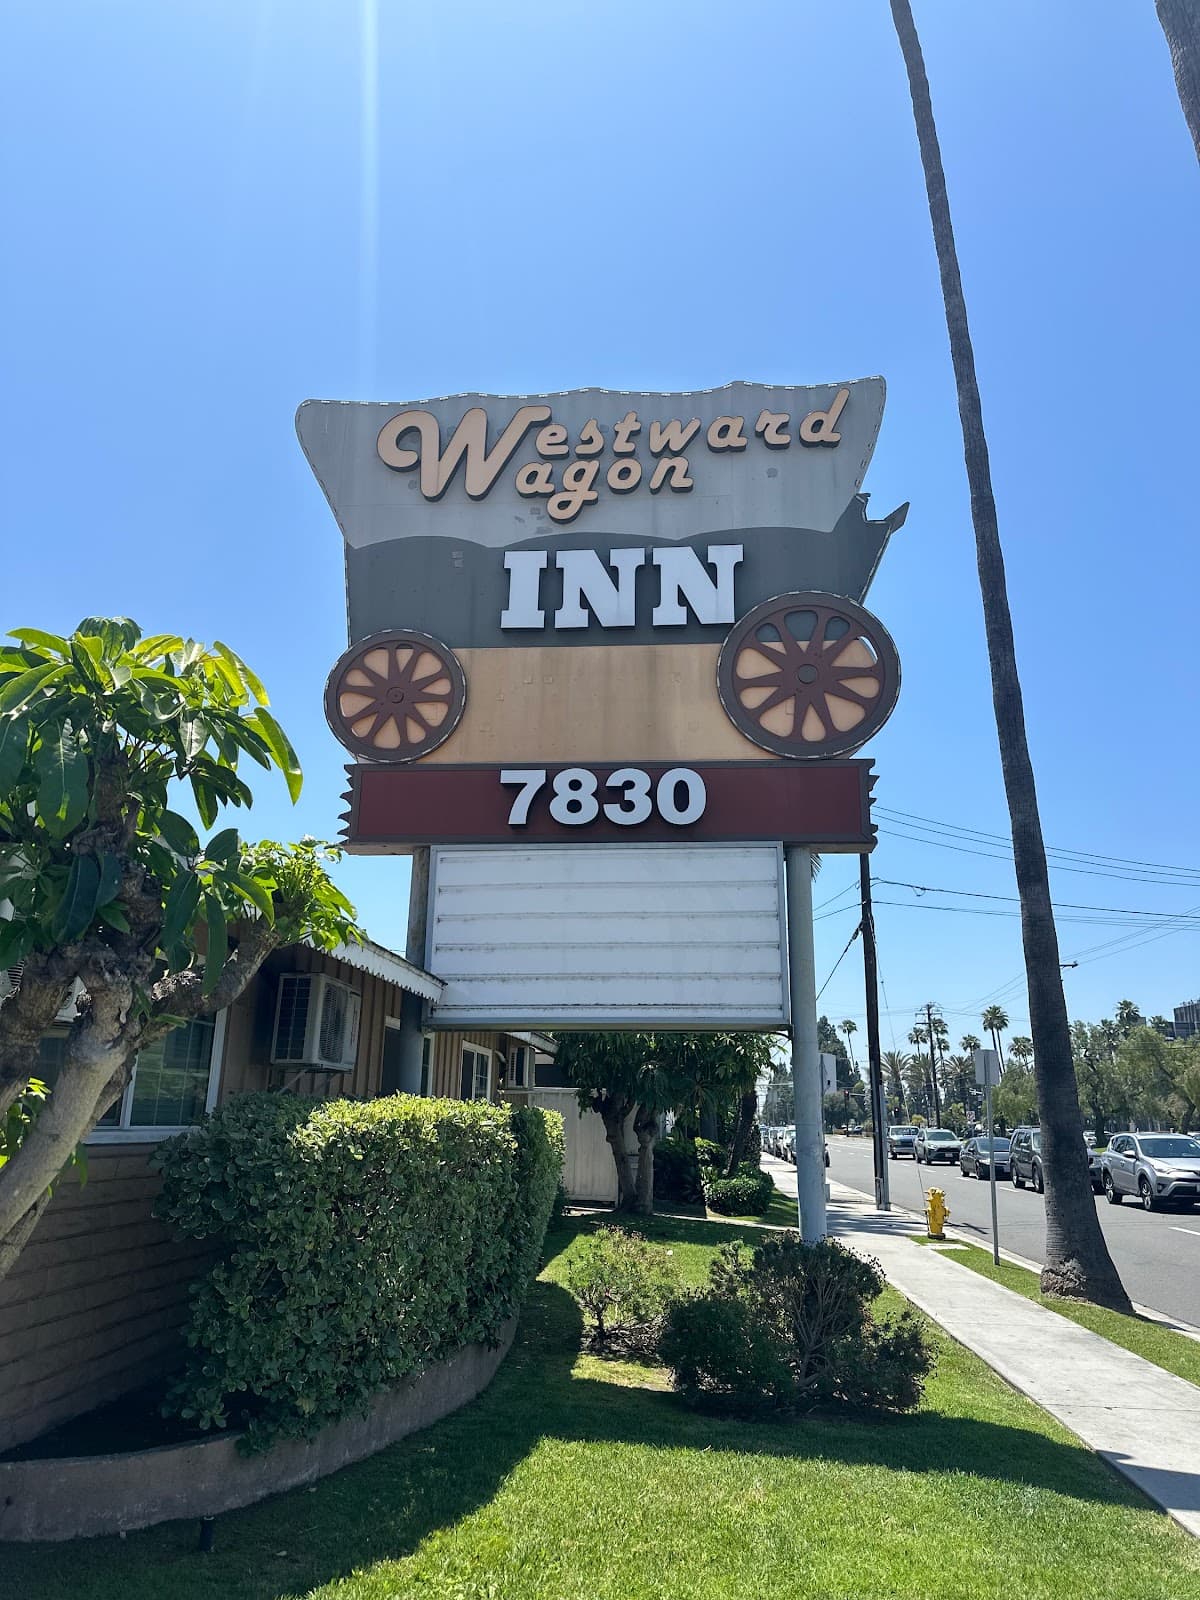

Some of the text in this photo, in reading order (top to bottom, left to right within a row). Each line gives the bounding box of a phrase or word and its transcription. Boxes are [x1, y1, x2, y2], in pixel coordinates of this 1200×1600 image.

[376, 389, 849, 500] Westward
[501, 544, 744, 629] INN
[501, 768, 707, 826] 7830
